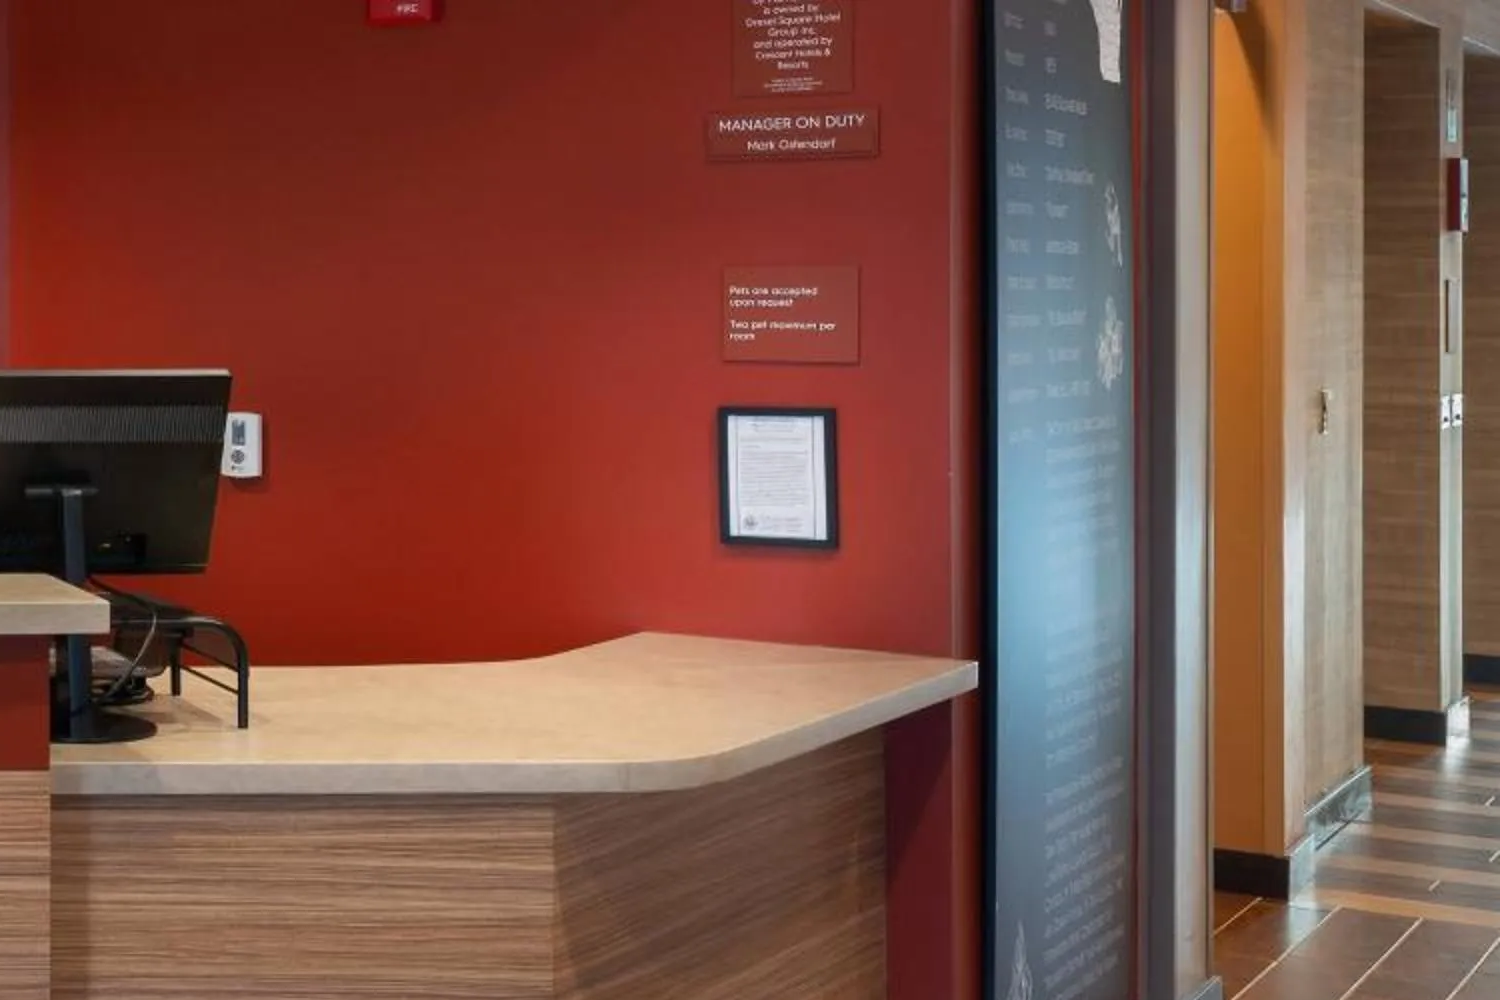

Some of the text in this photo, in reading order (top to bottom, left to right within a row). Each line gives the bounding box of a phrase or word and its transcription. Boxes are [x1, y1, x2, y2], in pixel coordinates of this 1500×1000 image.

[767, 27, 799, 37] Group
[719, 114, 865, 131] MANAGER ON DUTY
[747, 140, 775, 151] Mark
[729, 286, 750, 296] Pets
[771, 287, 819, 298] accepted
[729, 299, 756, 309] upon
[730, 319, 750, 329] Two
[819, 323, 837, 332] per
